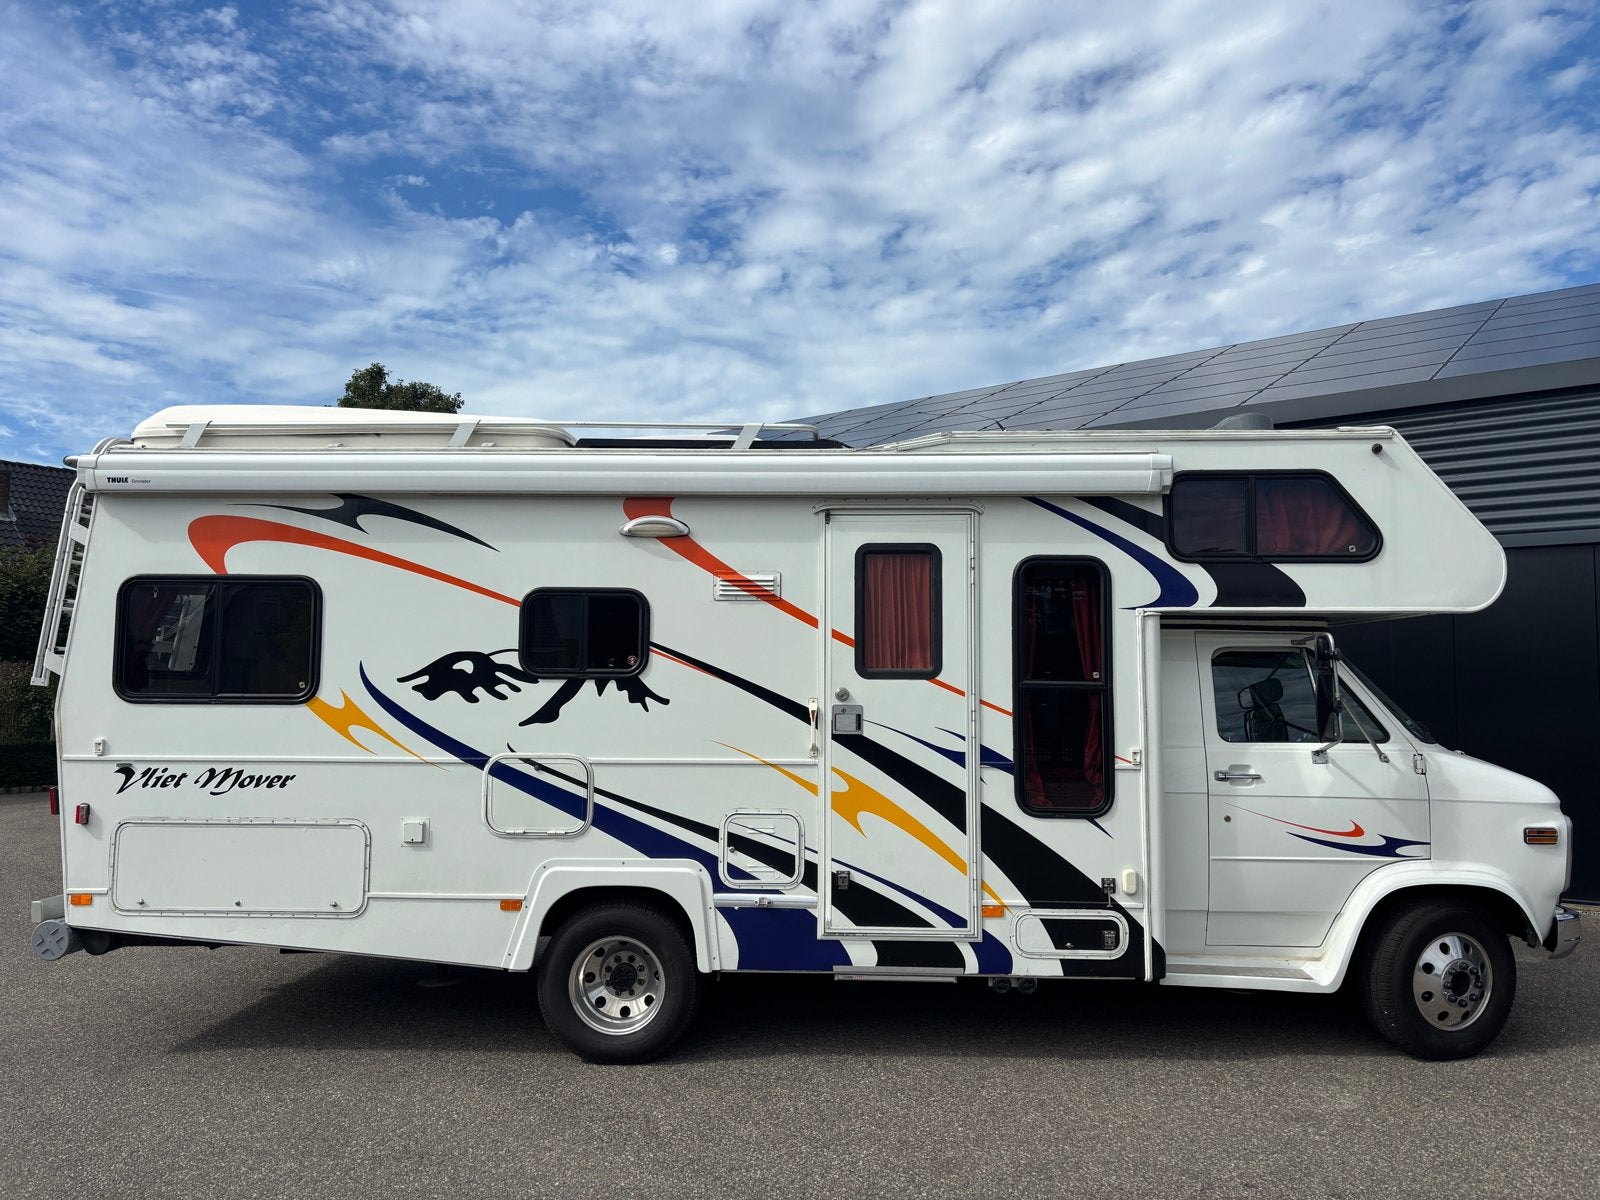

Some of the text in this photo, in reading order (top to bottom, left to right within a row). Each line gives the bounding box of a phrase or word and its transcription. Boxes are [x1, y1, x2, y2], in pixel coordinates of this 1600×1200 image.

[106, 476, 129, 484] THULE
[113, 766, 297, 796] Vliet Mover
